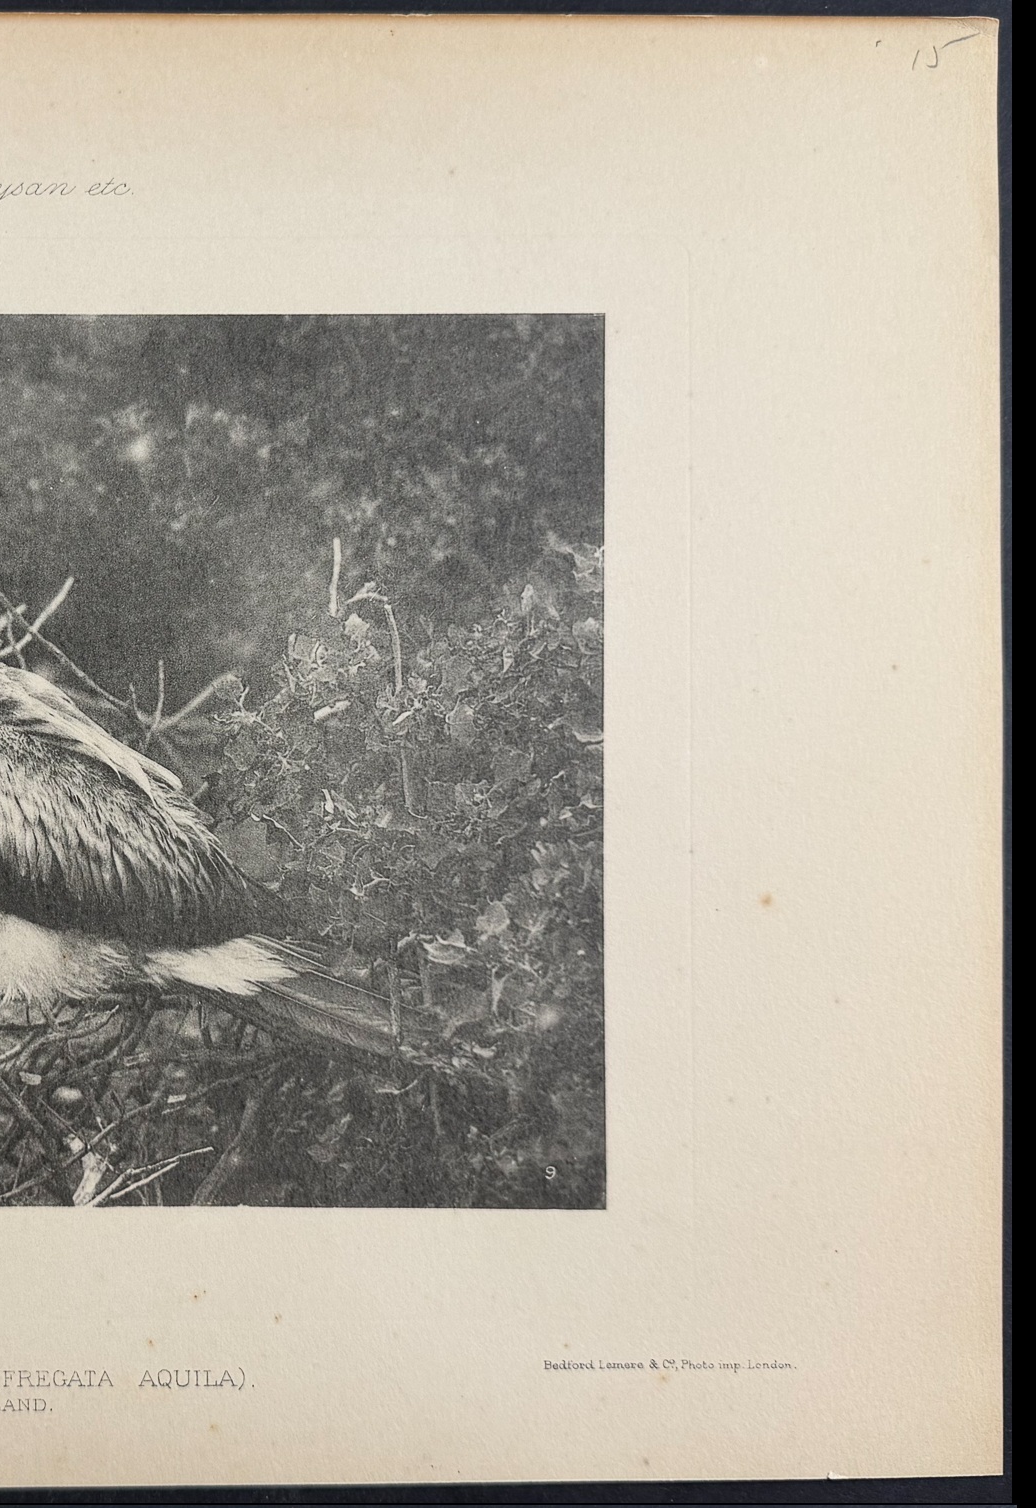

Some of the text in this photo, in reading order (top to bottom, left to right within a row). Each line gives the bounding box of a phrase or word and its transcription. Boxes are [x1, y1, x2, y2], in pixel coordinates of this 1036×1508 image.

[88, 177, 134, 197] etc.
[545, 1165, 556, 1180] 9
[544, 1359, 595, 1370] Bedford
[598, 1360, 644, 1370] Lemere
[648, 1358, 659, 1370] &
[681, 1358, 715, 1370] Photo
[748, 1359, 798, 1370] London.
[138, 1367, 256, 1390] AQUILA).
